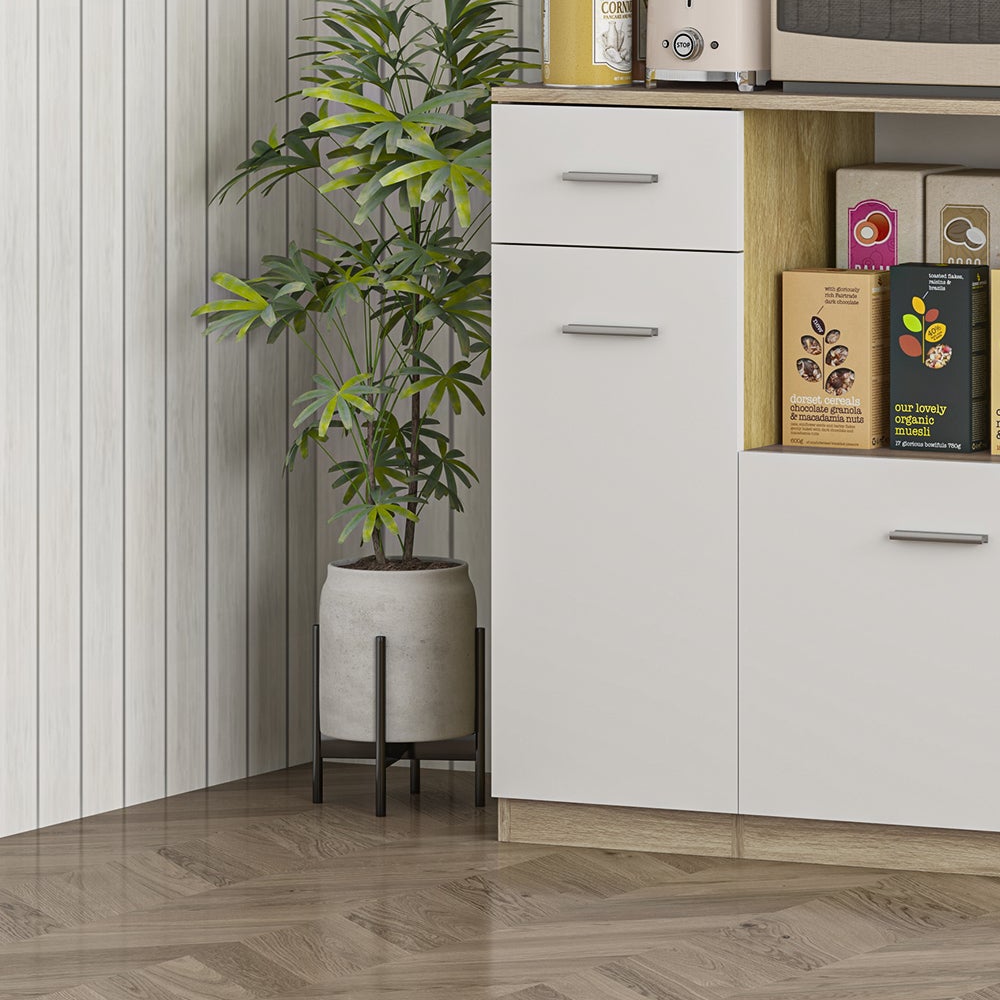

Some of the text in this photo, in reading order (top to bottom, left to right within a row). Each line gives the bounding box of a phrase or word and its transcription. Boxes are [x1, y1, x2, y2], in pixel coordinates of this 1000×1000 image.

[789, 394, 861, 406] dorset cereals
[790, 404, 862, 415] chocolate granola
[894, 403, 947, 416] our lovely
[790, 412, 864, 424] & macadamia nuts
[894, 415, 935, 426] organic
[894, 427, 931, 437] muesli
[901, 440, 924, 448] glorious
